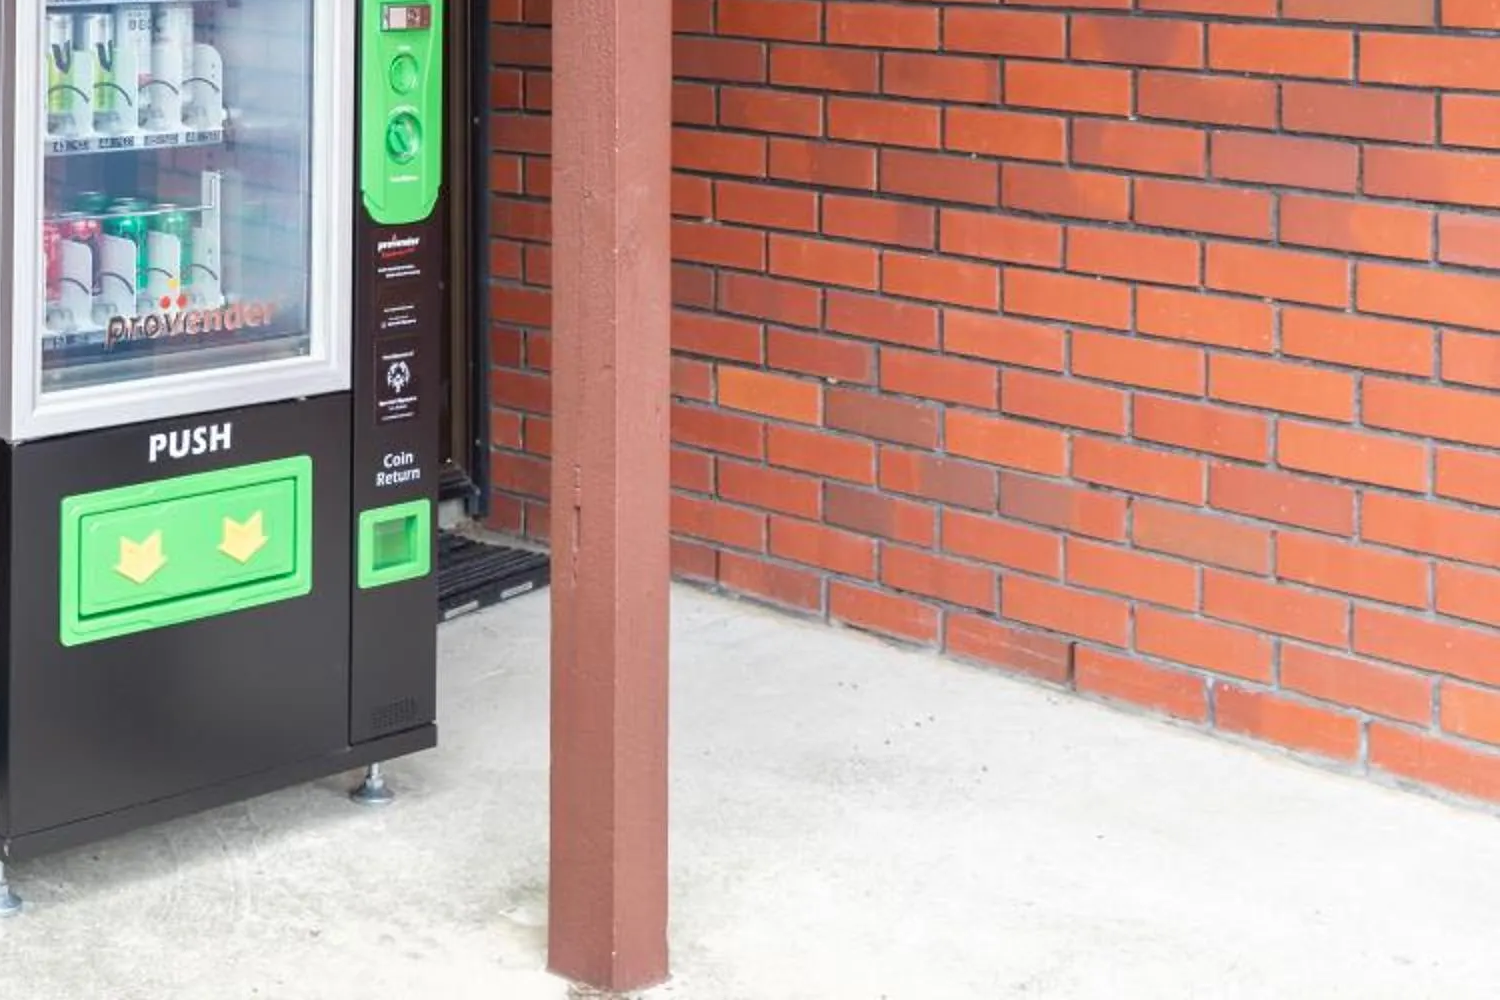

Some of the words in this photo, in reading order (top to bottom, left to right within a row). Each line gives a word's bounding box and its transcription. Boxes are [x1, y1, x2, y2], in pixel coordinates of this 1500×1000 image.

[106, 301, 275, 347] provender
[149, 423, 232, 462] PUSH
[383, 451, 413, 468] Coin
[376, 468, 420, 486] Return
